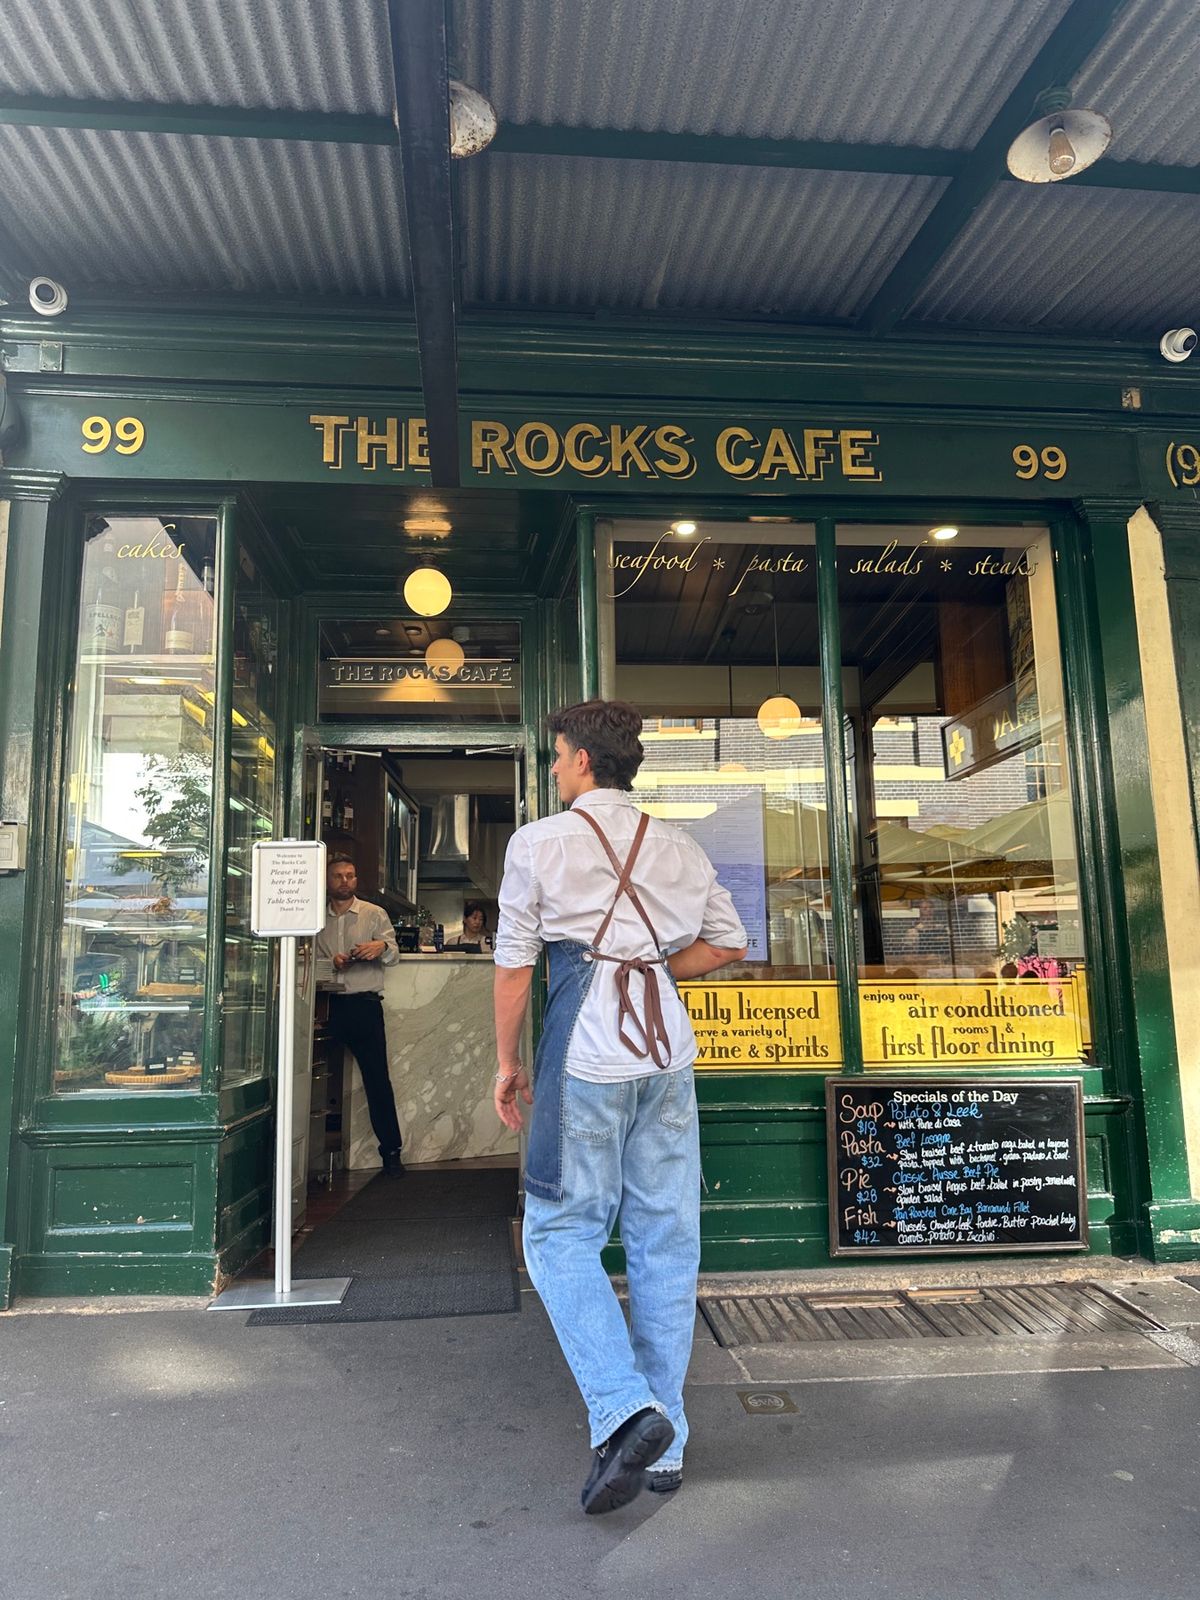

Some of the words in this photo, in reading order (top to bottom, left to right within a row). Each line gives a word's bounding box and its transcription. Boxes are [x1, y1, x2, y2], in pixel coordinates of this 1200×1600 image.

[81, 416, 145, 454] 99
[310, 415, 430, 471] THE
[471, 420, 698, 479] ROCKS
[716, 427, 882, 482] CAFE
[1012, 445, 1067, 480] 99
[117, 524, 186, 559] cakes
[606, 531, 712, 598] seafood
[728, 552, 809, 597] pasta
[850, 539, 929, 576] salads
[968, 544, 1039, 577] steaks
[332, 665, 374, 681] THE
[379, 664, 453, 682] ROCKS
[459, 665, 513, 682] CAFE
[271, 878, 286, 886] here
[863, 989, 895, 1003] enjoy
[898, 992, 921, 1001] our
[908, 998, 940, 1018] air
[943, 988, 1065, 1018] conditioned
[684, 991, 731, 1025] fully
[736, 991, 820, 1020] licensed
[694, 1029, 719, 1037] erve
[721, 1029, 729, 1037] a
[731, 1024, 773, 1039] variety
[775, 1020, 787, 1038] of
[953, 1026, 989, 1035] rooms
[1005, 1022, 1015, 1033] &
[697, 1038, 742, 1059] wine
[748, 1044, 761, 1059] &
[765, 1035, 829, 1063] spirits
[881, 1026, 925, 1060] first
[931, 1026, 981, 1059] floor
[986, 1026, 1055, 1057] dining
[840, 1094, 884, 1123] Soup
[893, 1091, 948, 1106] Specials
[952, 1091, 965, 1103] of
[967, 1091, 990, 1103] the
[992, 1091, 1019, 1105] Day
[887, 1100, 930, 1120] Potato
[931, 1102, 942, 1118] &
[946, 1101, 983, 1119] Leek
[856, 1119, 878, 1136] $18
[898, 1119, 915, 1129] with
[840, 1130, 887, 1158] Pasta
[894, 1131, 916, 1149] Beef
[920, 1133, 953, 1148] Lasagne
[899, 1149, 918, 1161] Slow
[921, 1146, 947, 1158] braised
[950, 1142, 966, 1154] beef
[974, 1140, 999, 1152] tomato
[861, 1155, 884, 1168] $32
[950, 1154, 966, 1165] with
[840, 1167, 872, 1191] Pie
[892, 1171, 929, 1185] Classic
[932, 1167, 961, 1181] Aussie
[962, 1165, 982, 1179] Beef
[983, 1163, 1000, 1178] Pie
[856, 1188, 878, 1204] $28
[897, 1183, 915, 1196] Slow
[946, 1180, 968, 1196] Angus
[1013, 1178, 1020, 1189] in
[844, 1204, 879, 1230] Fish
[896, 1218, 928, 1233] Mussels
[1001, 1215, 1030, 1229] Butter
[1060, 1211, 1077, 1232] baby
[854, 1228, 880, 1244] $42
